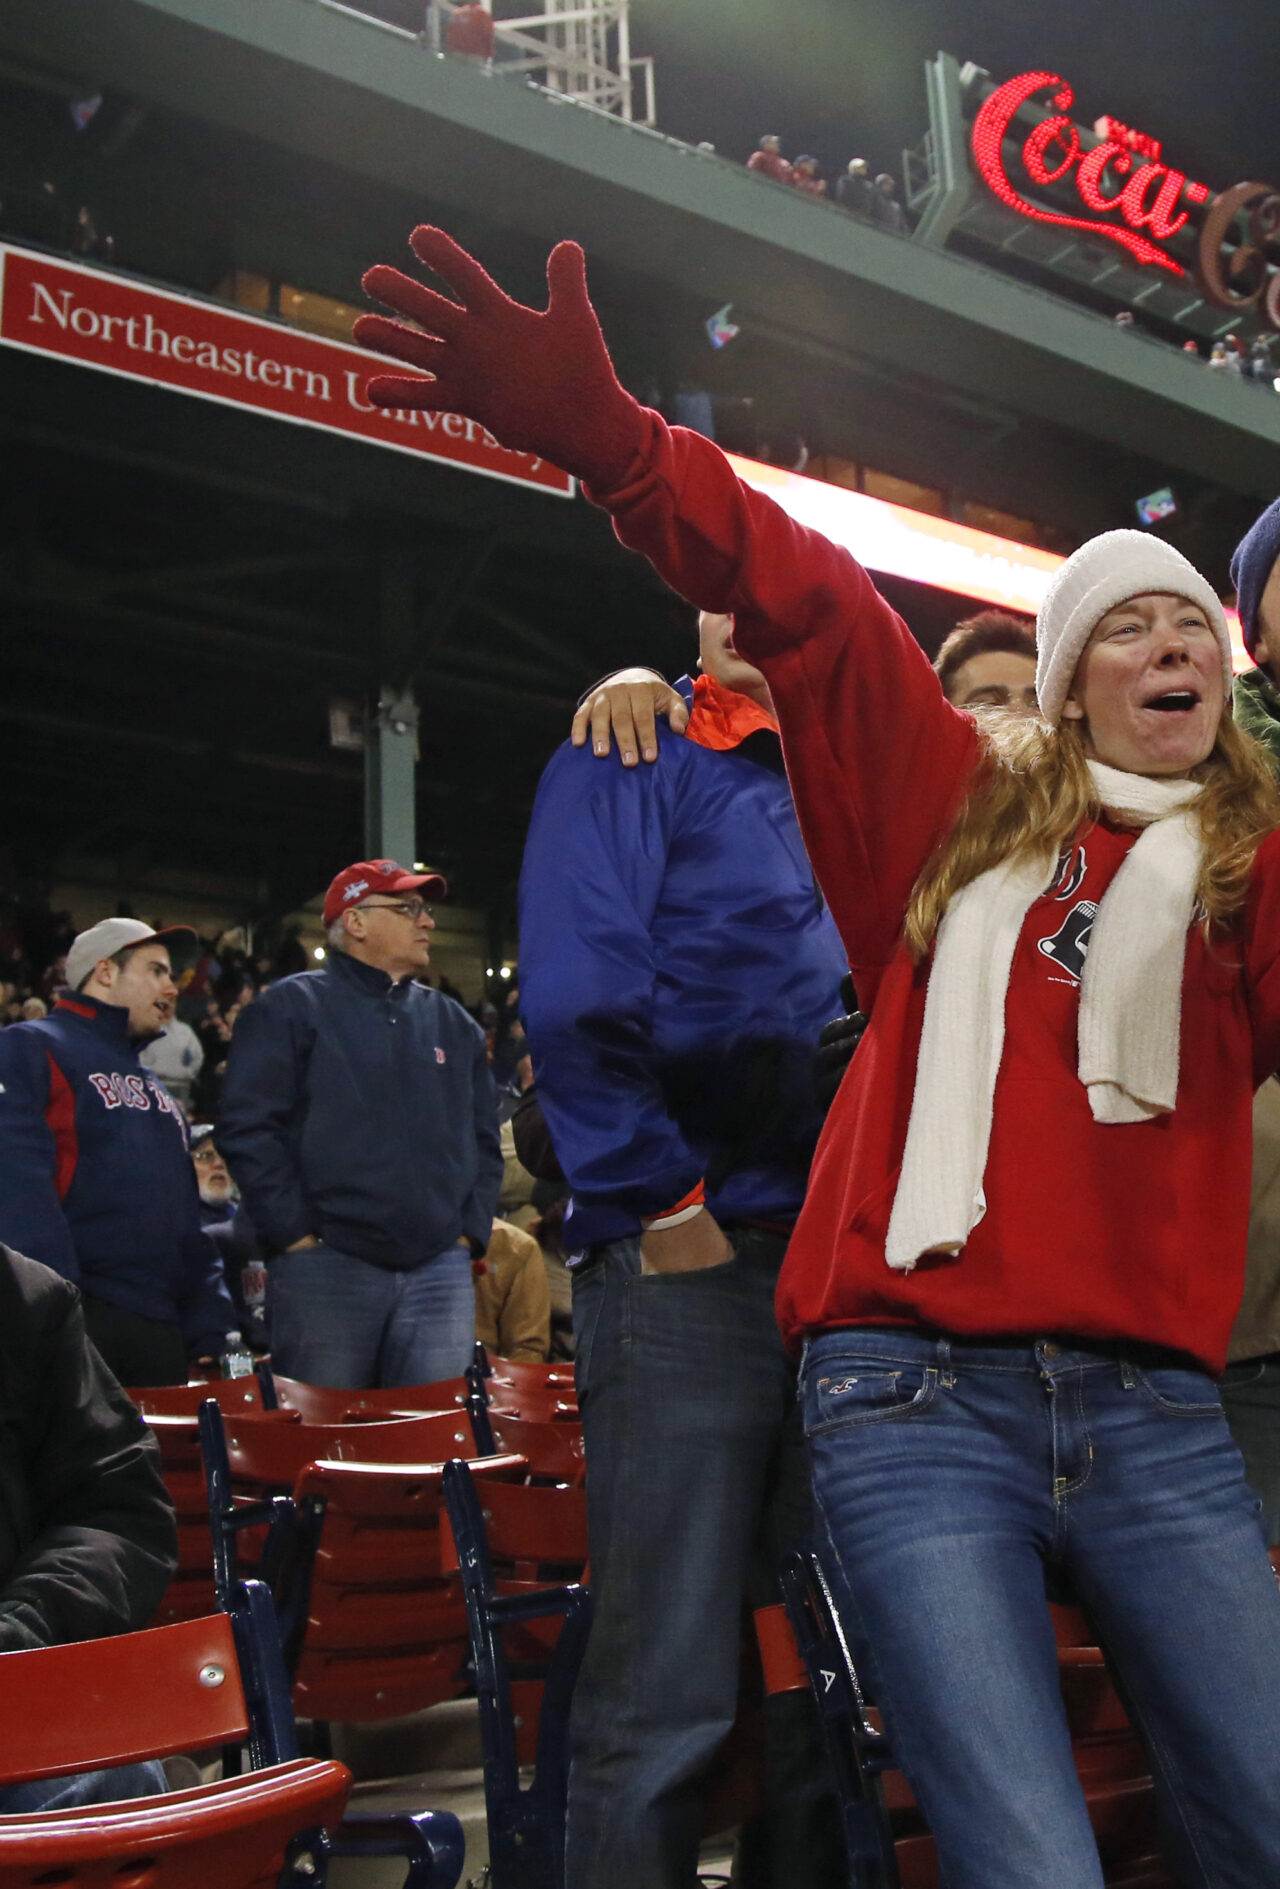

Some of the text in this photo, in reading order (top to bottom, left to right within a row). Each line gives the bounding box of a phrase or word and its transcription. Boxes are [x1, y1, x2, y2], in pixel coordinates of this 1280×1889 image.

[28, 282, 543, 472] Northeastern Univer
[89, 1072, 188, 1152] BOST
[820, 1669, 836, 1693] A
